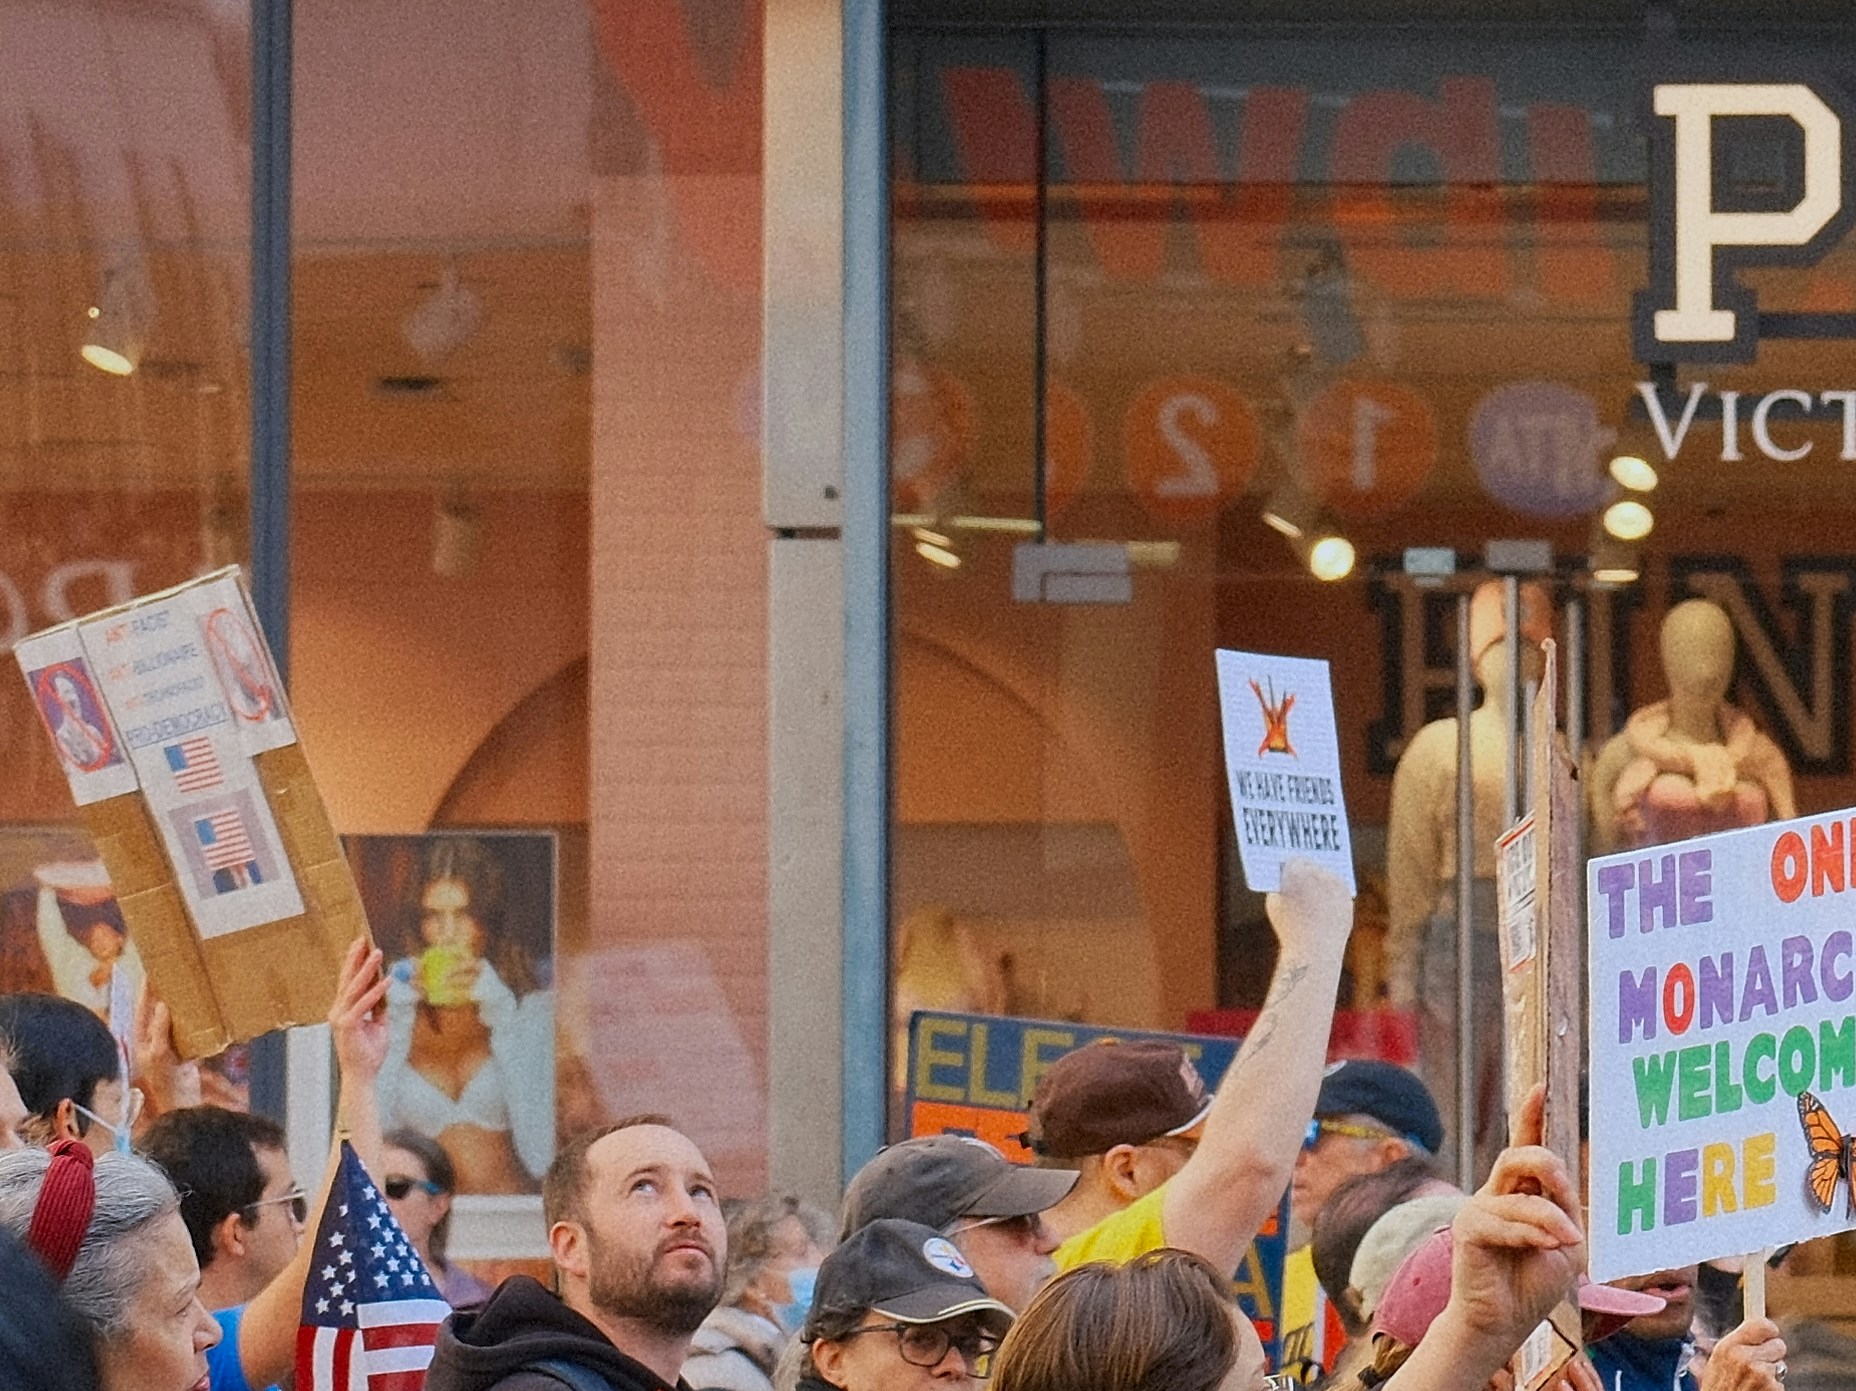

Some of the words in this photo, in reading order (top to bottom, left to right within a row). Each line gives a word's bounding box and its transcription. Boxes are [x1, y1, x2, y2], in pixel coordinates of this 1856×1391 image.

[1236, 770, 1254, 800] WE
[1255, 771, 1285, 803] HAVE
[1287, 774, 1334, 806] FRIENDS
[1243, 807, 1340, 851] EVERYWHERE
[1598, 848, 1713, 939] THE
[1617, 1133, 1776, 1235] HERE
